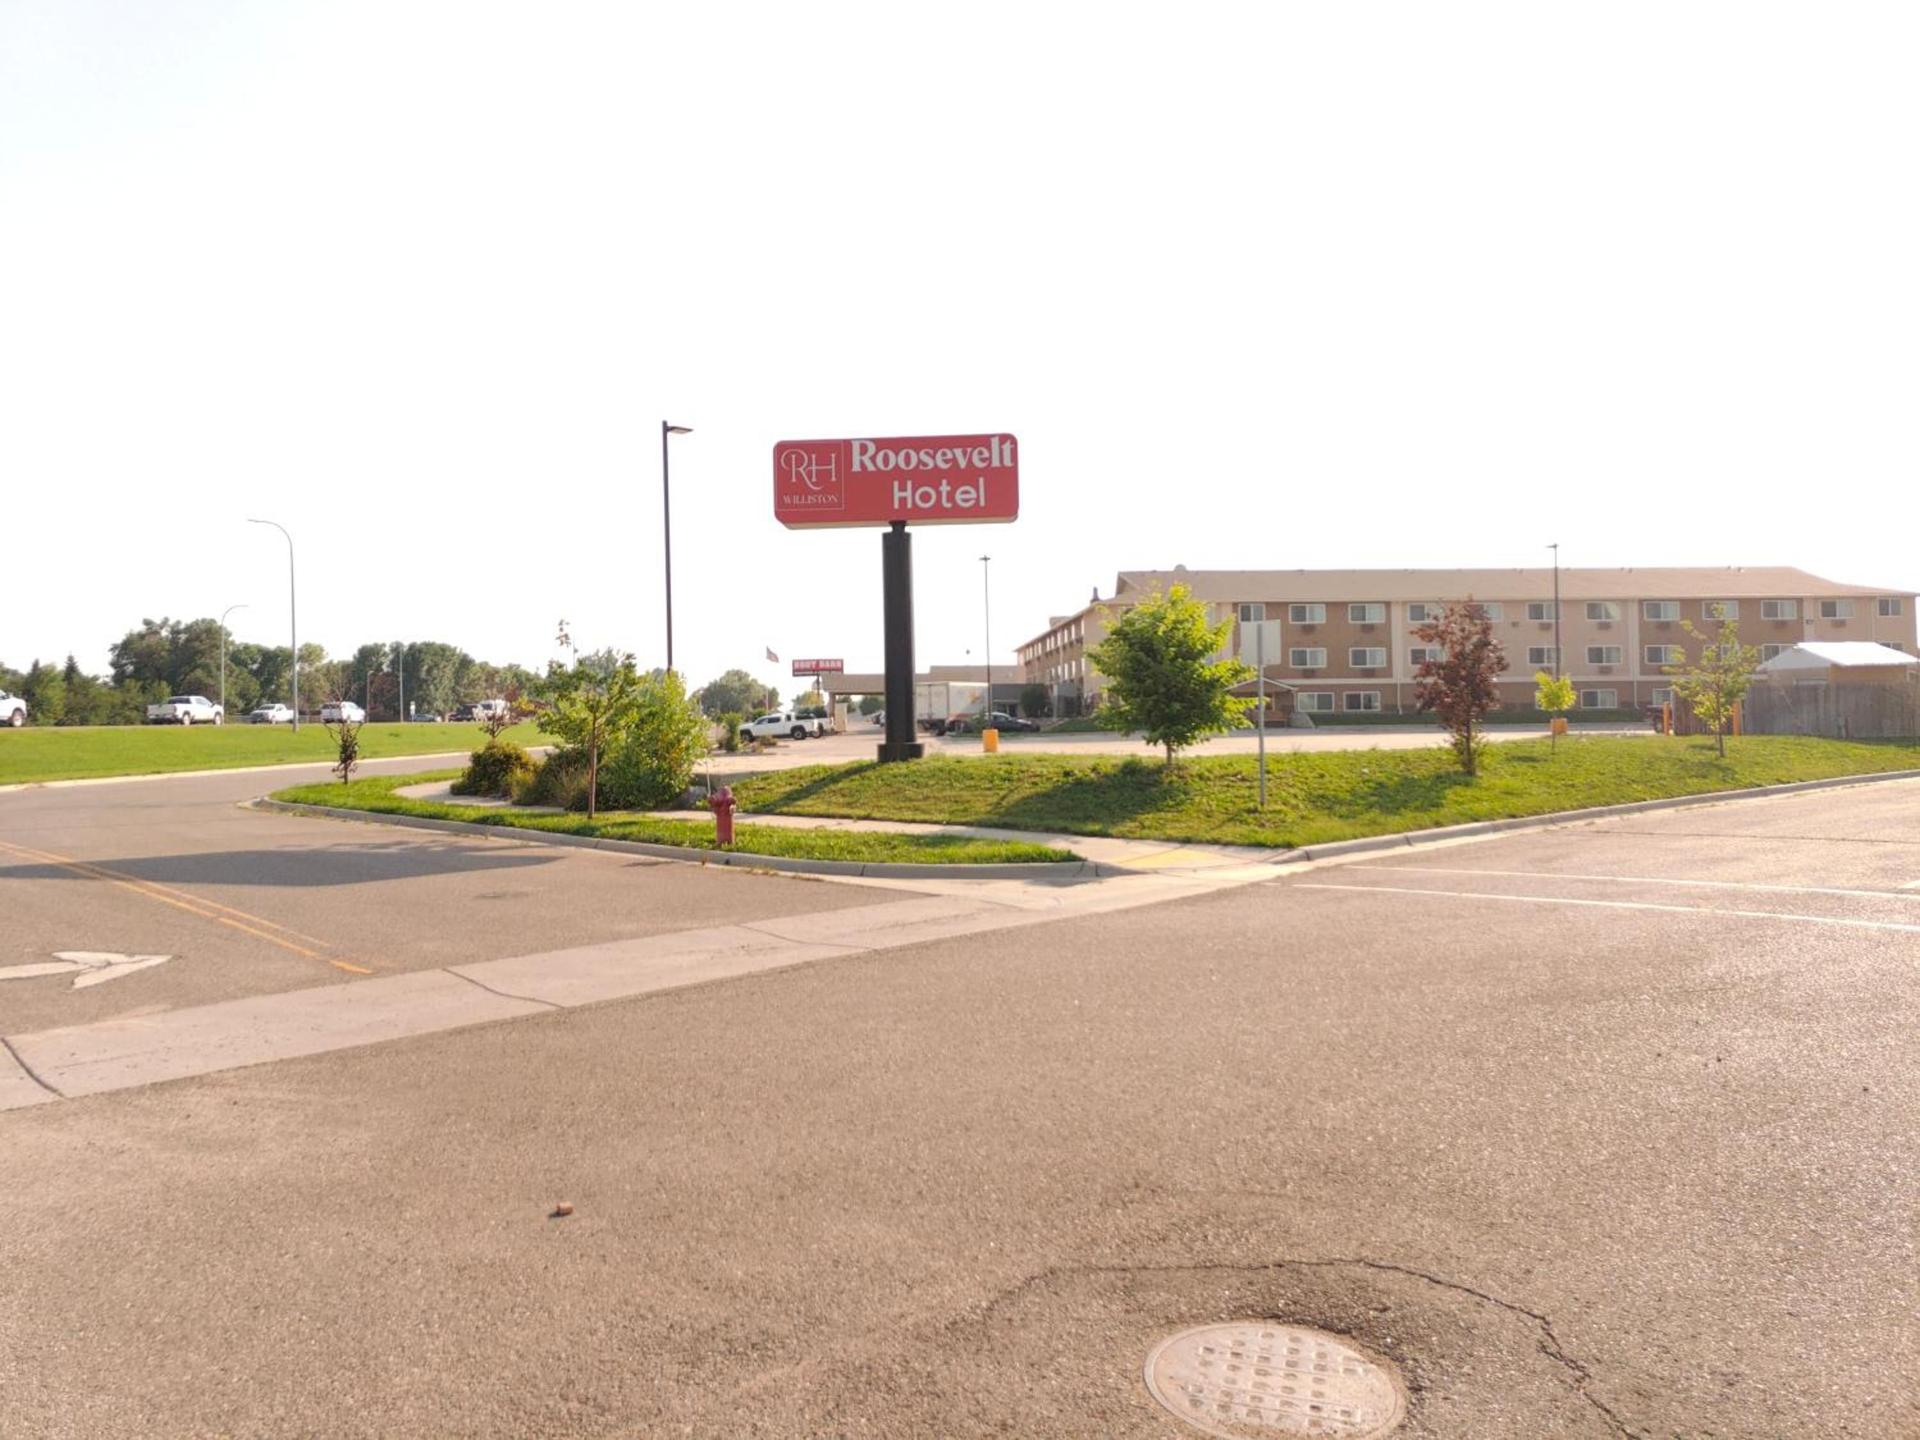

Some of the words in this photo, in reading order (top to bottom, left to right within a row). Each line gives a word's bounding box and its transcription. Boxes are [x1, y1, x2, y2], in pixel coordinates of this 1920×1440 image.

[781, 448, 837, 490] RH
[851, 437, 1015, 472] Roosevelt
[783, 494, 839, 505] WILLISTON
[893, 477, 985, 509] Hotel
